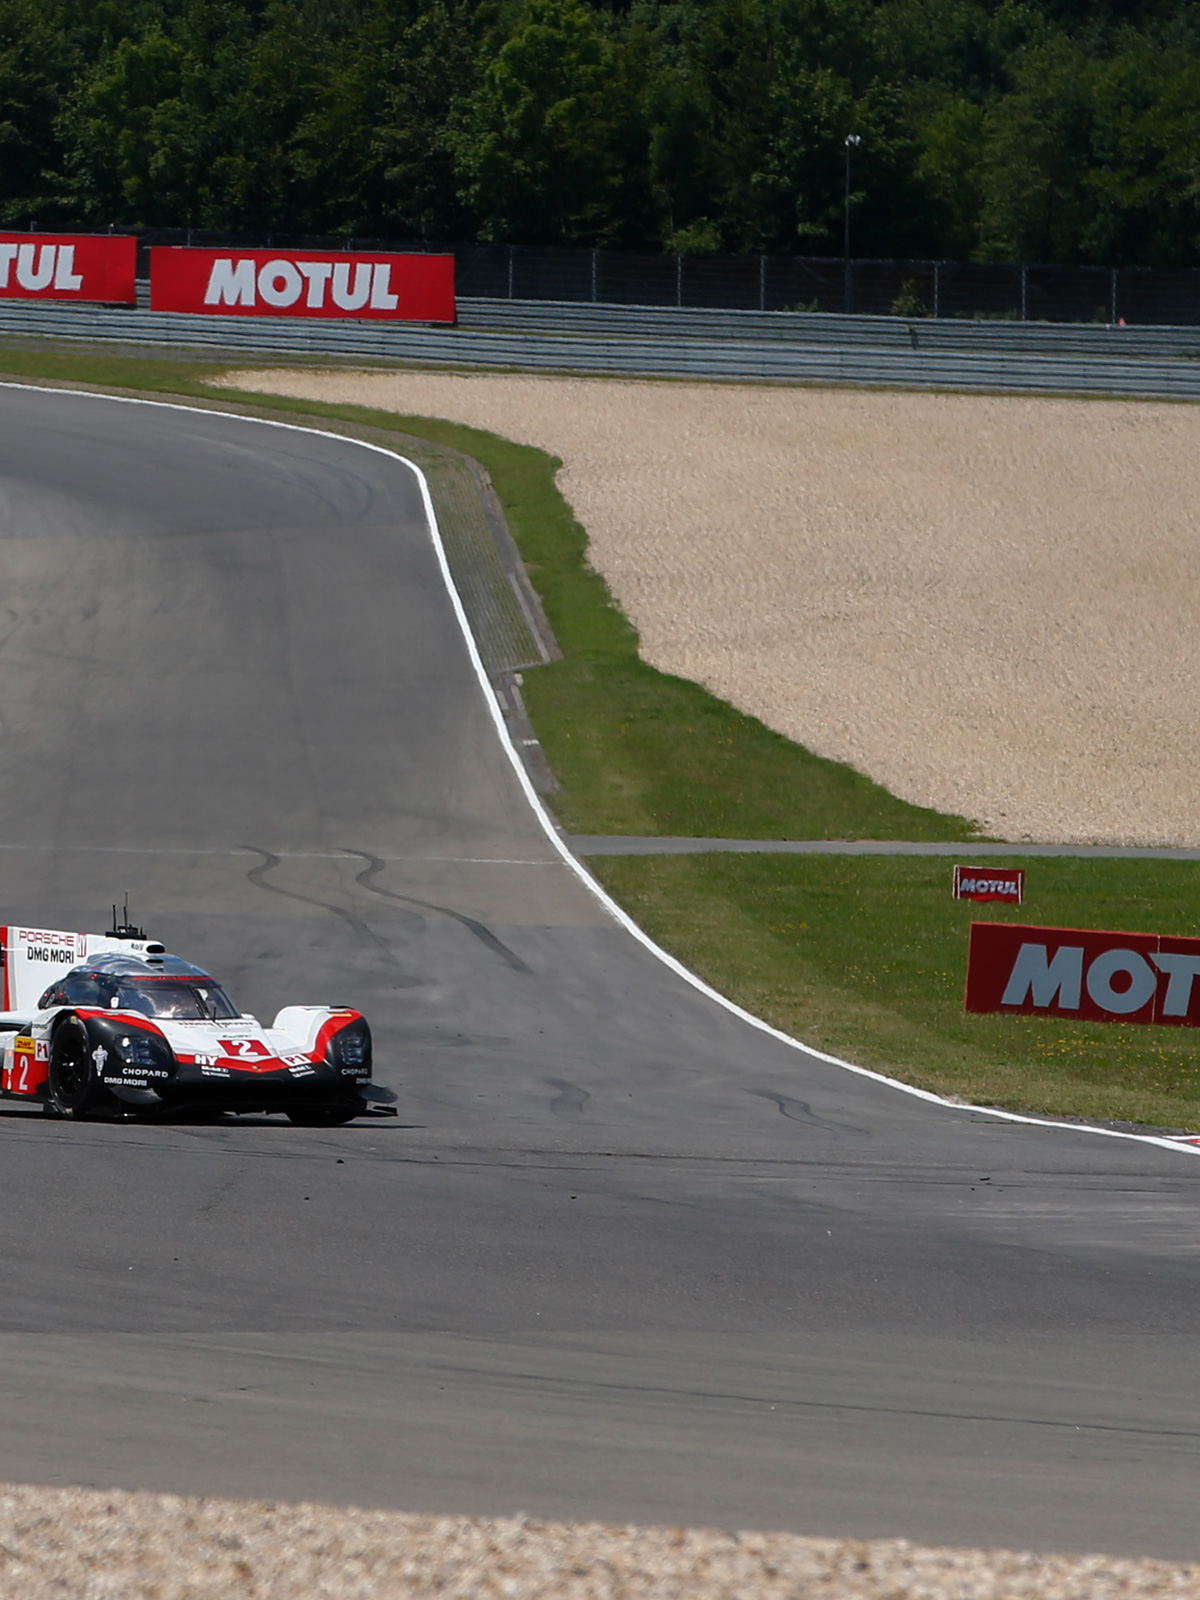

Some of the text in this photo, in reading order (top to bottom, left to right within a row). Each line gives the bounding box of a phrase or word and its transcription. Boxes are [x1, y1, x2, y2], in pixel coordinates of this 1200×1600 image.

[204, 258, 399, 311] MOTUL
[960, 878, 1018, 895] MOTUL
[19, 930, 75, 947] PORSCHE
[27, 946, 75, 964] DMG MORI
[1001, 943, 1200, 1016] MOT
[37, 1043, 49, 1058] P1
[230, 1040, 259, 1056] 2
[194, 1054, 219, 1066] HY
[19, 1055, 29, 1091] 2
[104, 1076, 123, 1085] DMG
[122, 1068, 169, 1078] CHOPARD
